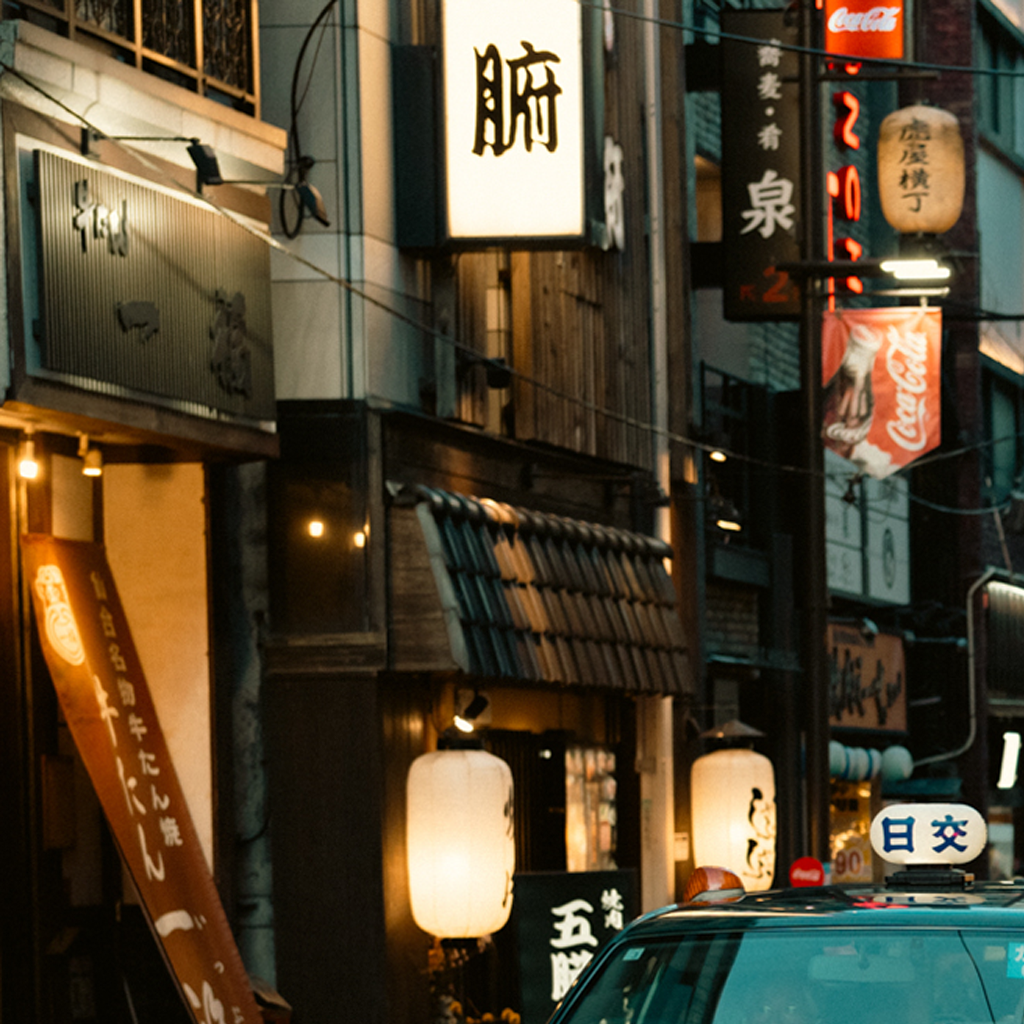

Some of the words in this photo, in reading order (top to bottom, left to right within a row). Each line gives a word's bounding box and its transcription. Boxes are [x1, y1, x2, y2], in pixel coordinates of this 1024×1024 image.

[473, 41, 562, 156] 腑
[740, 169, 796, 239] 泉
[886, 325, 927, 452] Coca-Cola
[882, 815, 968, 853] 日交
